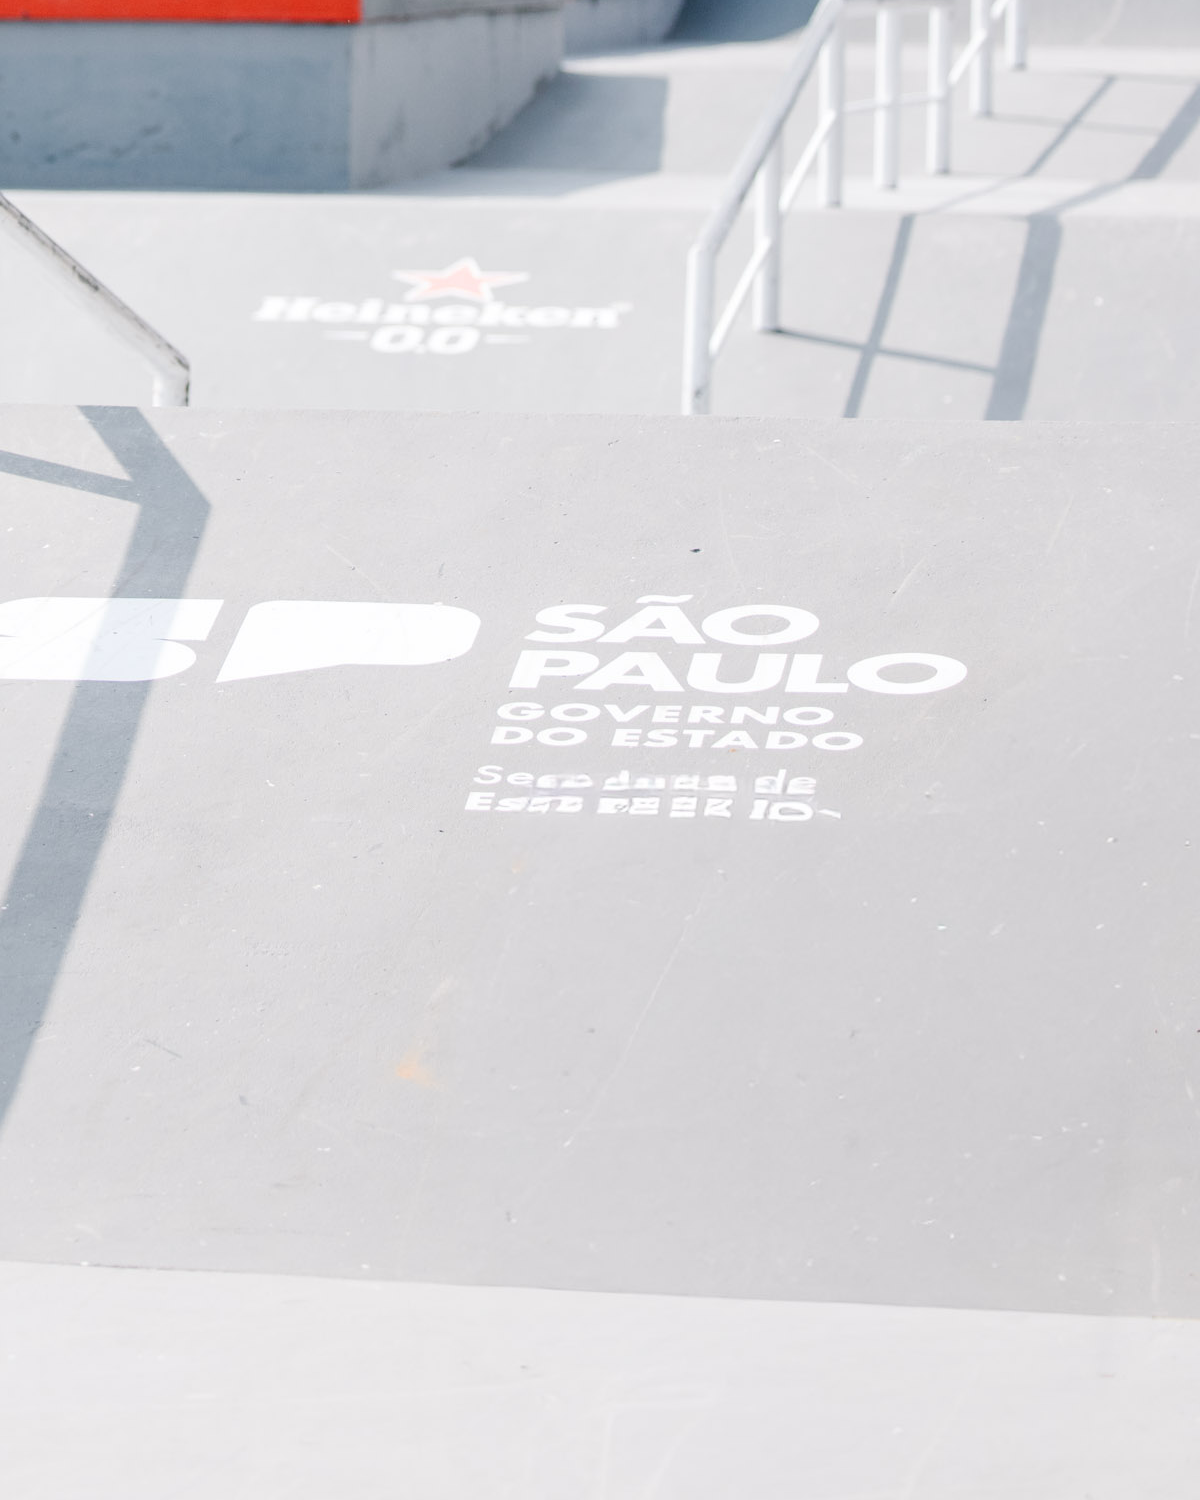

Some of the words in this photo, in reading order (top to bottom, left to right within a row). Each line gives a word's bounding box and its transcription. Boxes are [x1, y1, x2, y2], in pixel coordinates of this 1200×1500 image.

[251, 297, 620, 329] Heineken
[370, 325, 480, 354] 0.0
[524, 595, 820, 646] SÃO
[508, 650, 968, 695] PAULO
[496, 701, 834, 726] GOVERNO
[490, 726, 588, 747] DO
[611, 728, 864, 751] ESTADO
